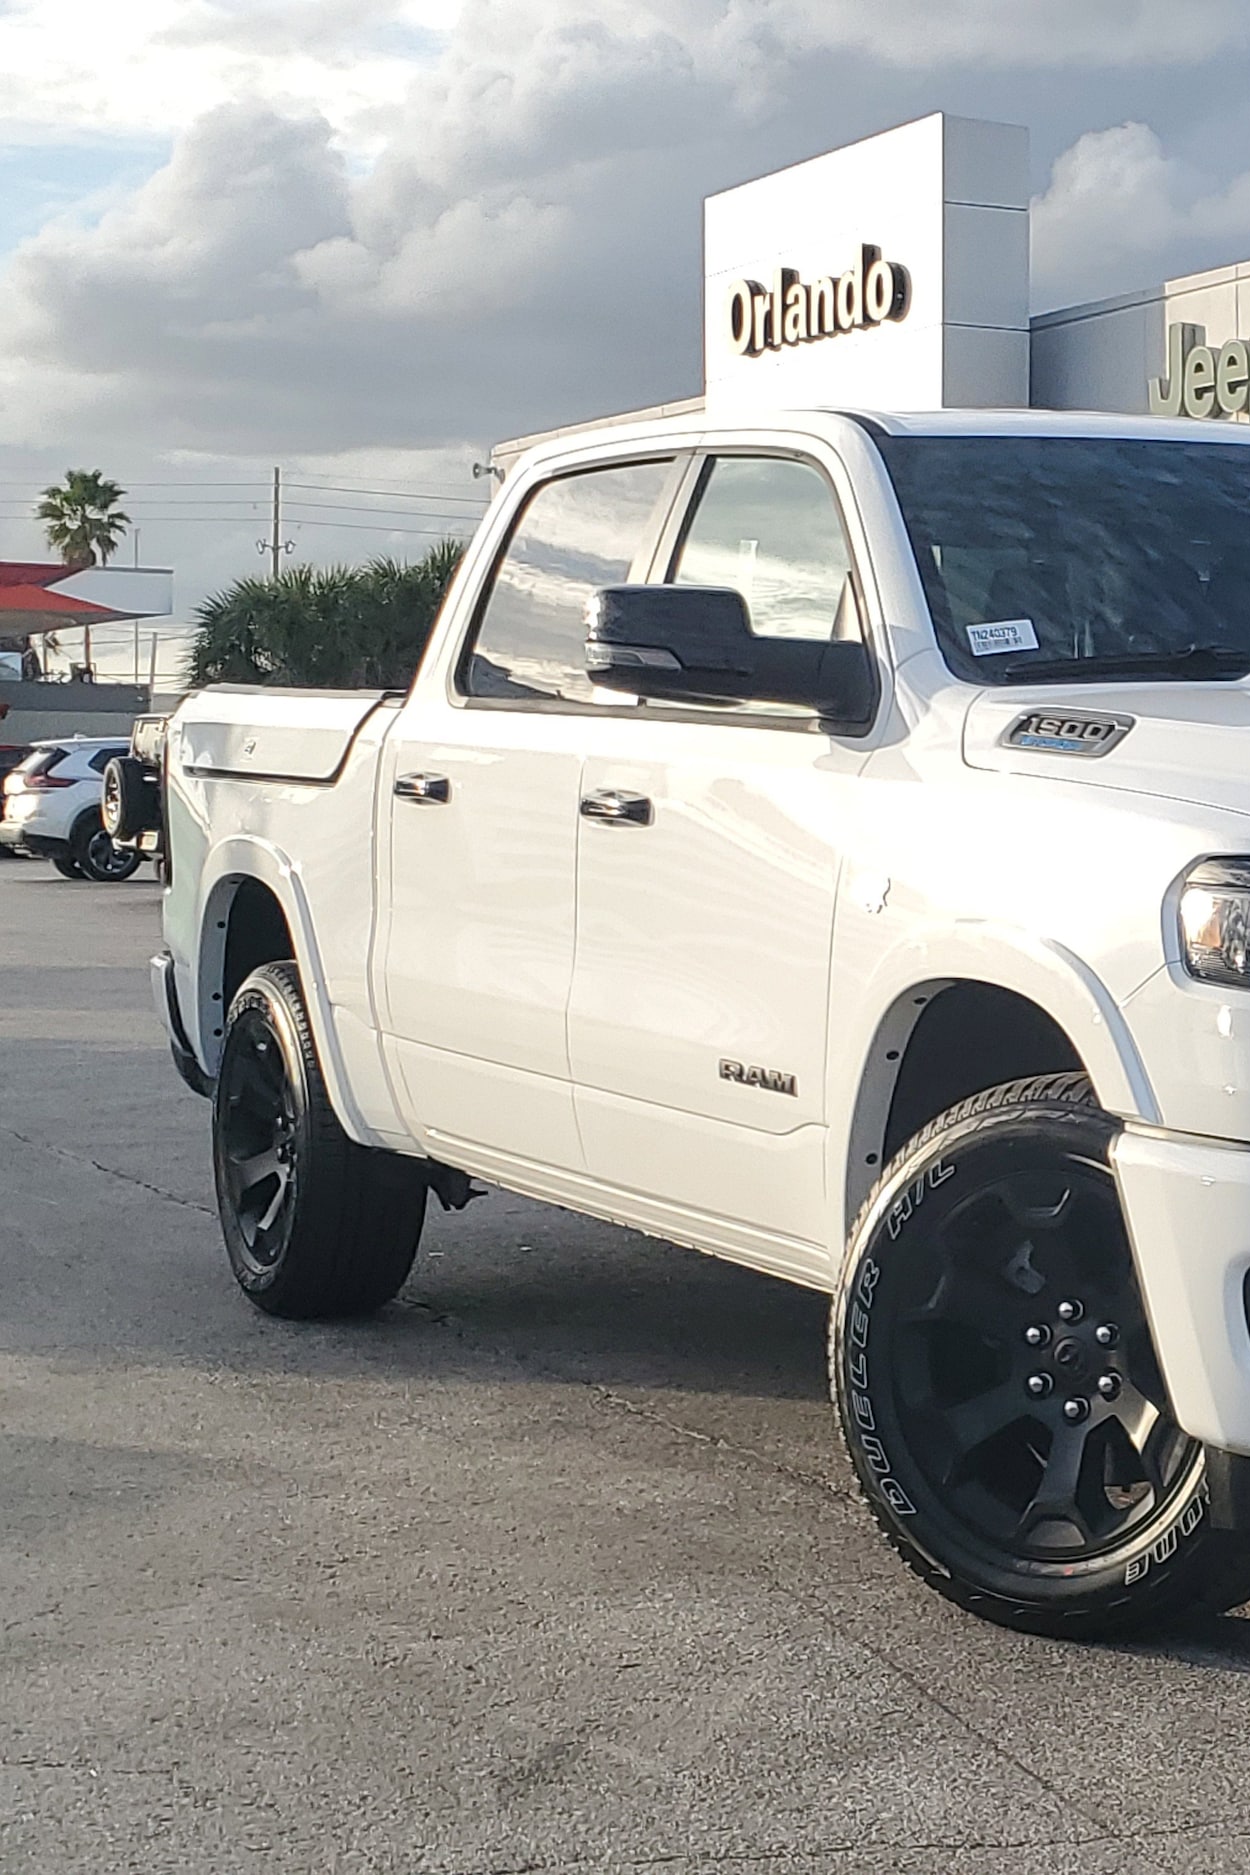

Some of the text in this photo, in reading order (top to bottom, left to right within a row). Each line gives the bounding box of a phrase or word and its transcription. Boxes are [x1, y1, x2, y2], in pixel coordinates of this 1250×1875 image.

[727, 243, 908, 356] Orlando
[1025, 716, 1112, 742] 1500
[718, 1058, 799, 1098] RAM
[850, 1258, 918, 1515] DUELER
